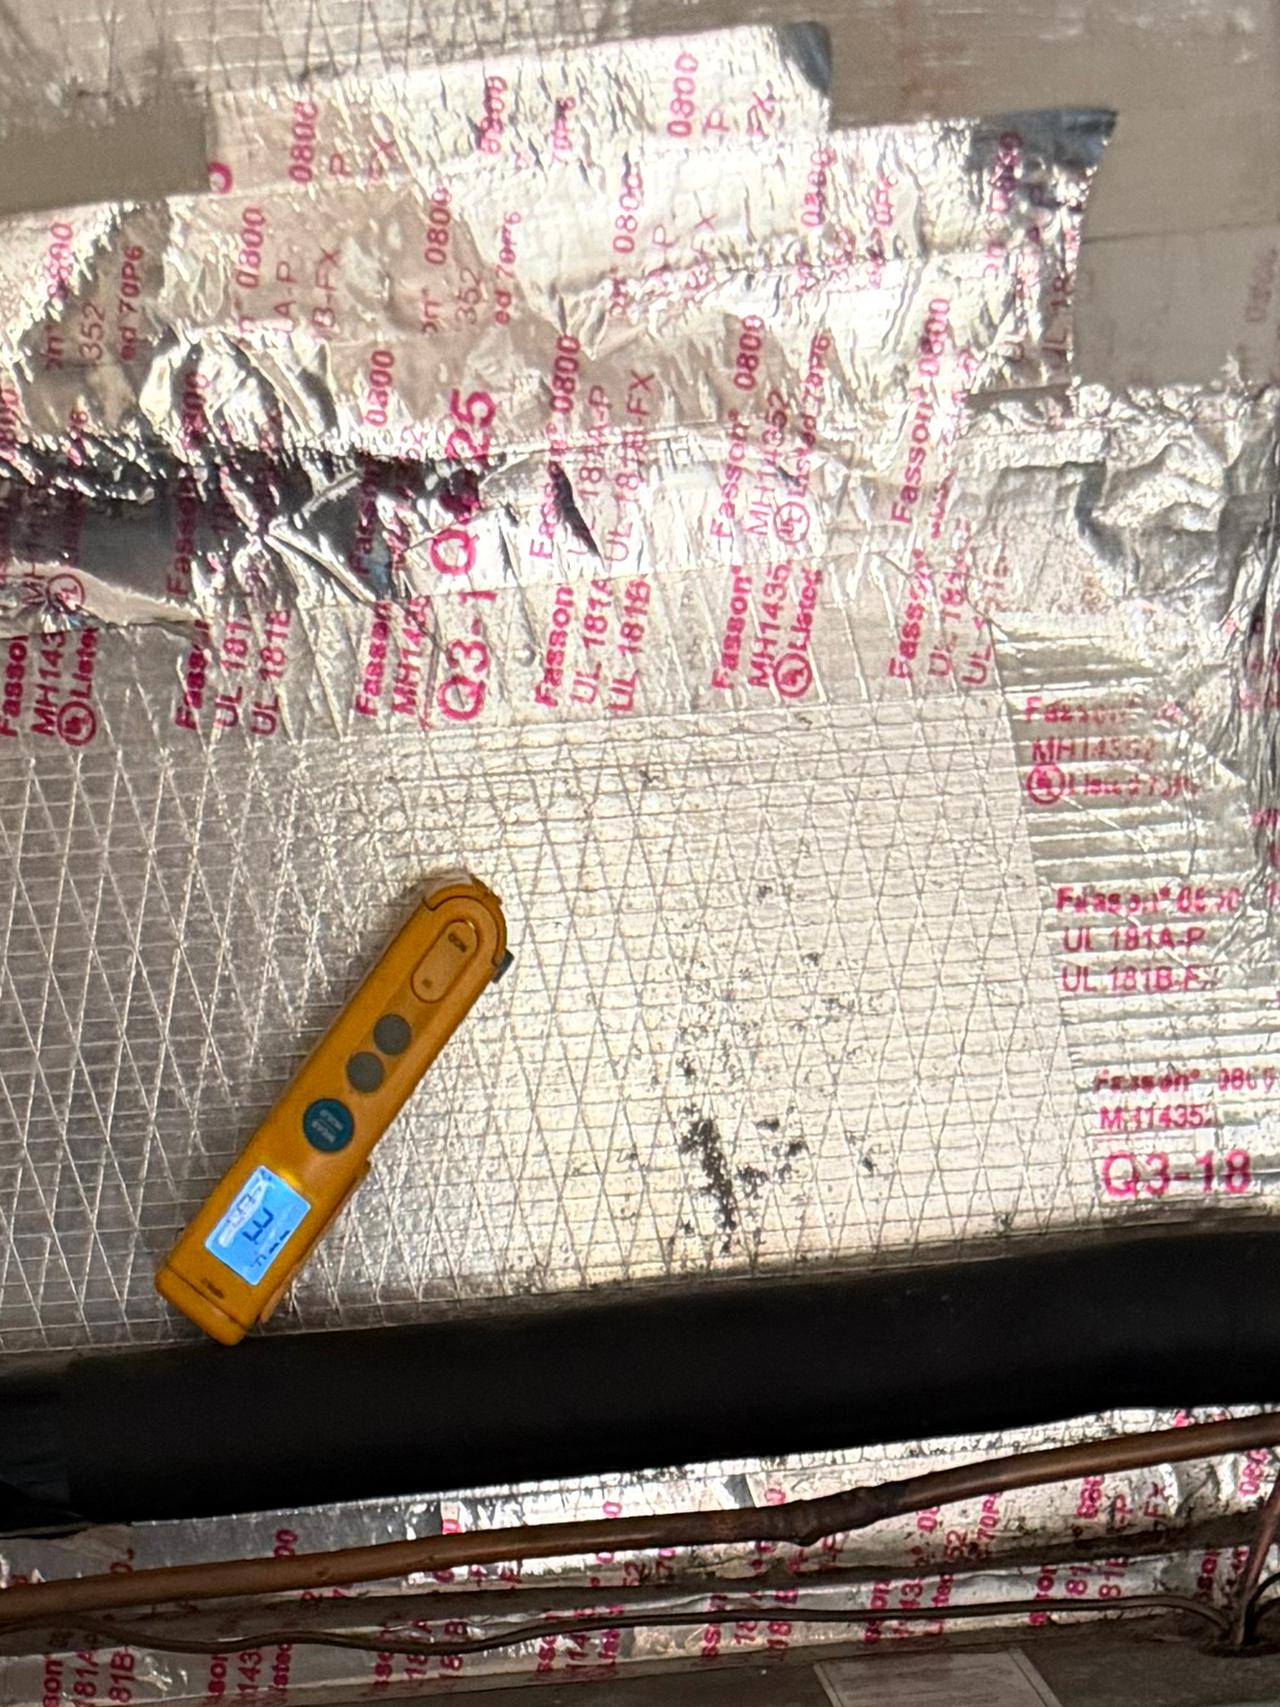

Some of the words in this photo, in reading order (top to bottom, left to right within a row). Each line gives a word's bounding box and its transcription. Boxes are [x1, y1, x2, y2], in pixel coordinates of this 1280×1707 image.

[667, 49, 699, 138] 0800
[236, 206, 266, 289] 0800
[425, 187, 452, 266] 0800
[549, 333, 582, 415] 0800
[571, 662, 602, 705] UL
[608, 669, 639, 712] UL
[214, 686, 242, 728] UL
[250, 694, 280, 737] UL
[1061, 965, 1093, 992] UL
[1102, 1150, 1252, 1198] Q3-18
